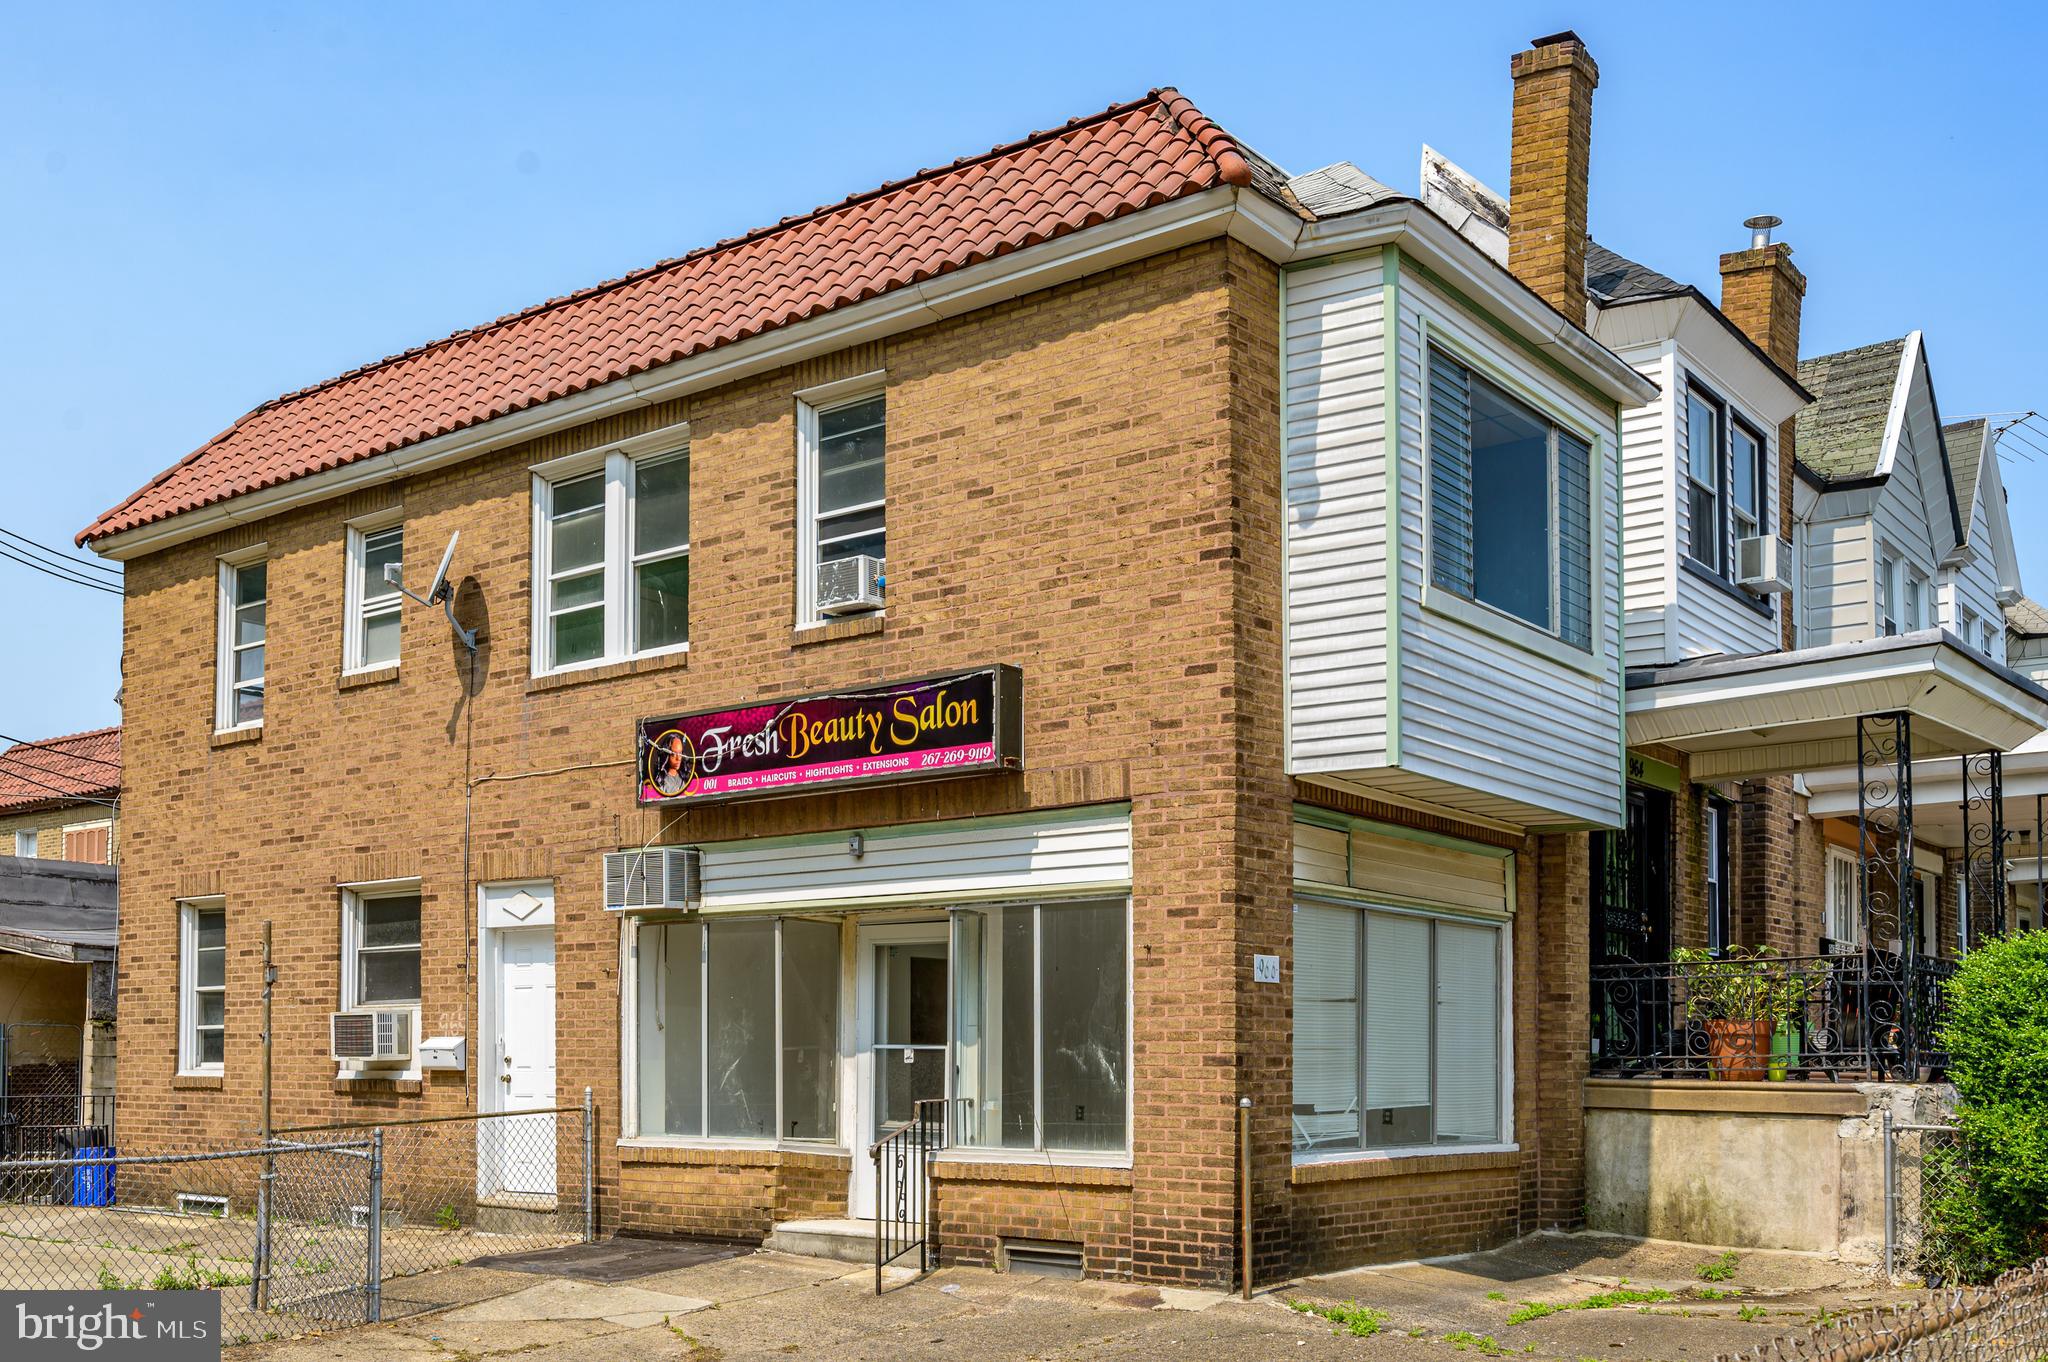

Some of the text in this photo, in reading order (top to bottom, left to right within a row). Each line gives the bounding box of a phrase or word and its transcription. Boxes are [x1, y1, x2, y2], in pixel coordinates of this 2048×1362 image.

[700, 690, 979, 773] Fresh Beauty Salon
[727, 777, 753, 787] BRAIDS
[761, 771, 797, 783] HAIRCUTS
[805, 764, 854, 778] HIGHTLIGHTS
[862, 757, 909, 771] EXTENSIONS
[921, 746, 991, 766] 267-269-9119
[1629, 757, 1644, 778] 964
